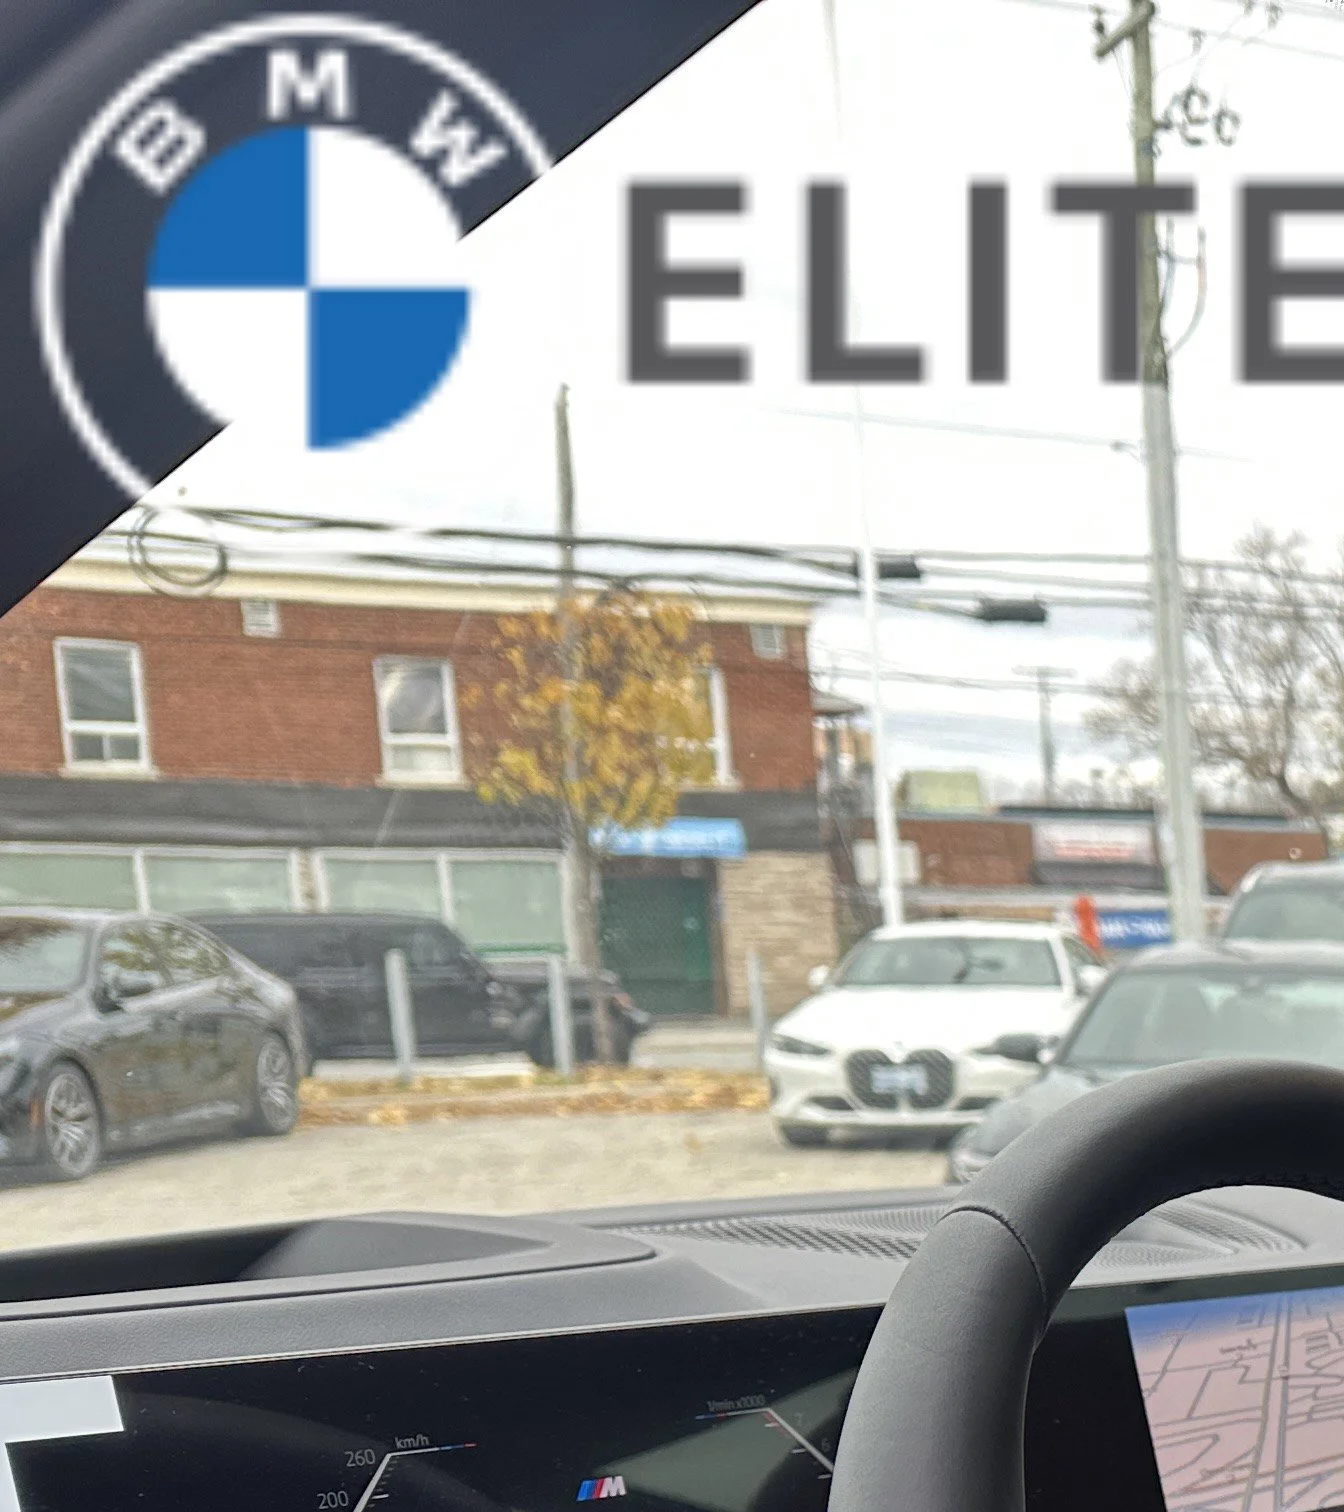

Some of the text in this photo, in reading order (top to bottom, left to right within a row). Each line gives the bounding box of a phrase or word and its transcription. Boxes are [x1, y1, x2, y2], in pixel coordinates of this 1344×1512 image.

[395, 1434, 430, 1450] km/h
[344, 1449, 377, 1468] 260
[316, 1490, 350, 1510] 200
